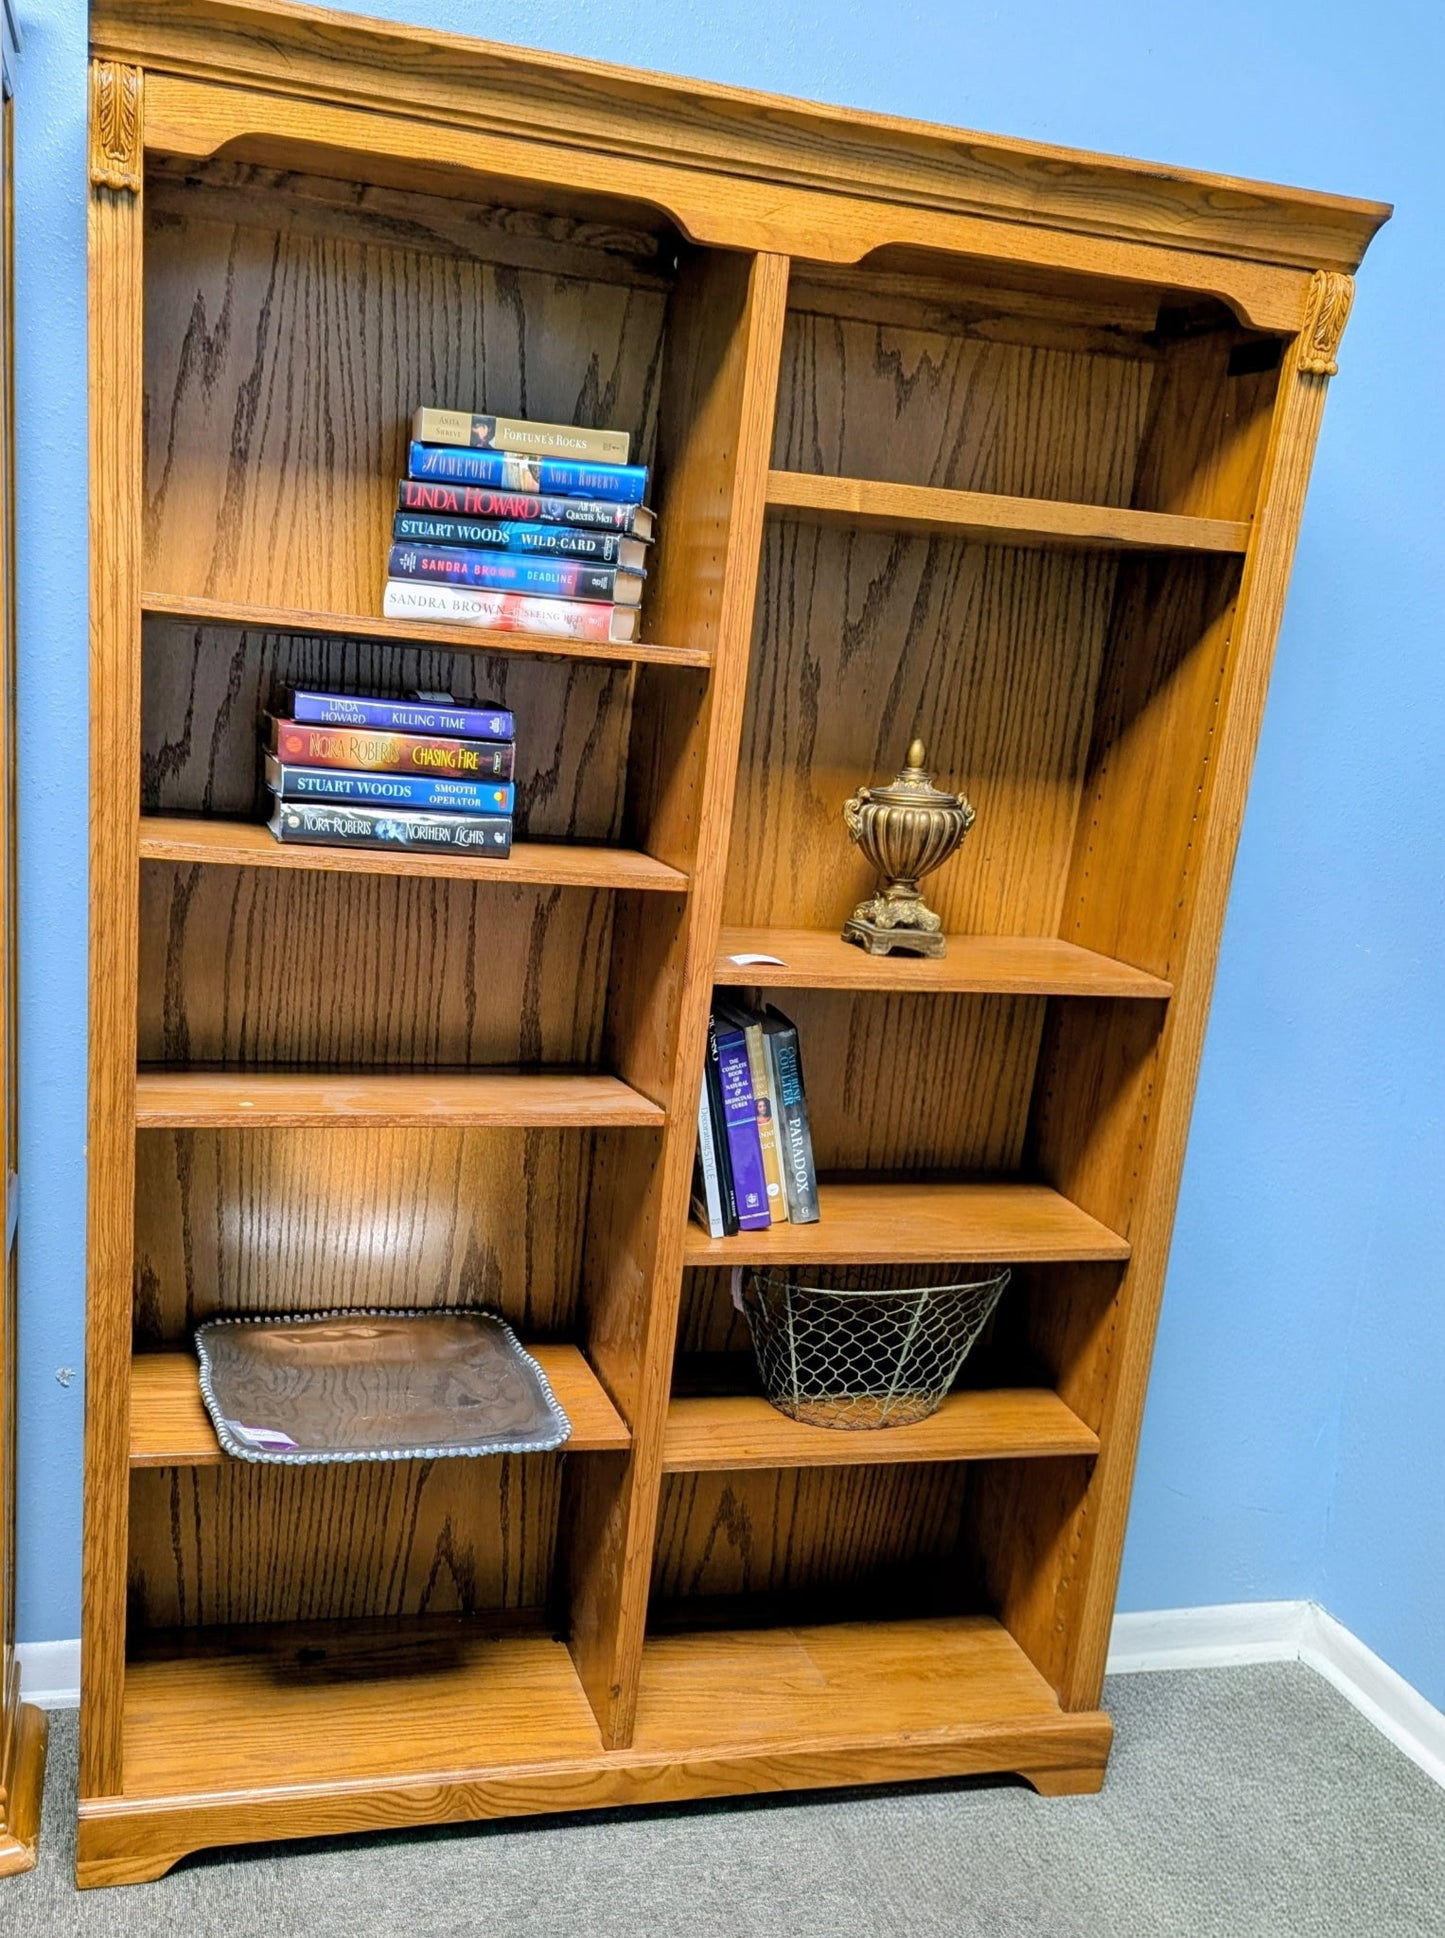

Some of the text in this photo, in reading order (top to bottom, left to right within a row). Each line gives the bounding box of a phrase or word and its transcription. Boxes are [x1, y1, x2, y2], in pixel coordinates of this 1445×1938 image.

[439, 415, 460, 427] ANITA
[436, 426, 462, 438] SHREVE
[503, 427, 554, 446] FORTUNE'S
[556, 432, 588, 449] ROCKS
[421, 450, 495, 480] HOMEPORT
[549, 467, 573, 486] NORA
[578, 467, 620, 490] ROBERTS
[406, 480, 540, 519] LINDA HOWARD
[578, 500, 603, 514] All the
[565, 508, 594, 525] Queen's
[595, 511, 613, 525] Men
[401, 519, 454, 542] STUART
[456, 524, 511, 544] WOODS
[559, 537, 597, 552] CARD
[421, 558, 574, 585] SANDRA BROWN DEADLINE
[389, 592, 447, 611] SANDRA
[452, 595, 506, 616] BROWN
[523, 608, 560, 621] SEEING
[328, 700, 359, 713] LINDA
[321, 710, 367, 724] HOWARD
[391, 711, 466, 730] KILLING TIME
[309, 733, 344, 758] NORA
[349, 734, 401, 766] ROBERTS
[411, 745, 455, 768] CHASING
[457, 748, 480, 771] FIRE
[297, 777, 412, 798] STUART WOODS
[434, 783, 477, 795] SMOOTH
[429, 795, 481, 808] OPERATOR
[303, 815, 485, 848] NORA ROBERTS NORTHERN LIGHTS
[721, 1061, 748, 1074] COMPLETE
[725, 1080, 749, 1091] NATURAL
[778, 1048, 795, 1107] COULTER
[724, 1093, 753, 1106] MEDICINAL
[731, 1101, 749, 1111] CURES
[789, 1117, 809, 1194] PARADOX
